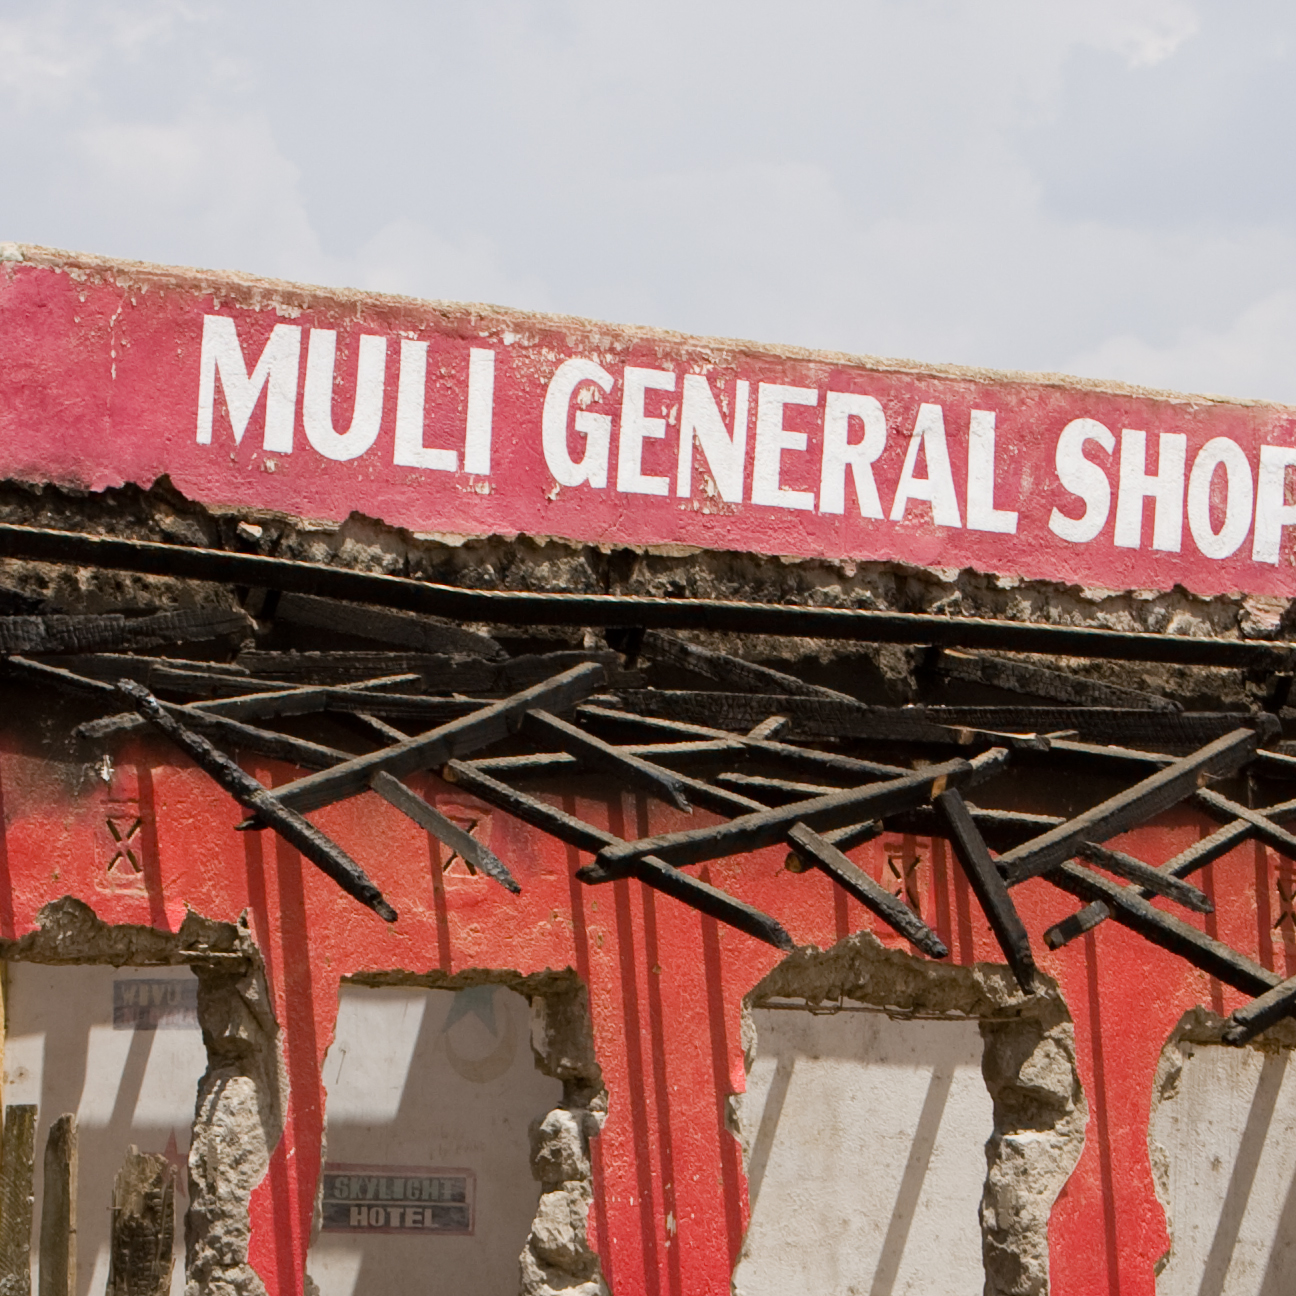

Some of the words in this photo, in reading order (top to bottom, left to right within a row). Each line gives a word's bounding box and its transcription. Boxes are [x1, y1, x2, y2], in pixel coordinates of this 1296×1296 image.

[196, 313, 496, 476] MULI
[542, 356, 1018, 534] GENERAL
[334, 1176, 454, 1200] SKYLIGHT
[349, 1206, 439, 1228] HOTEL
